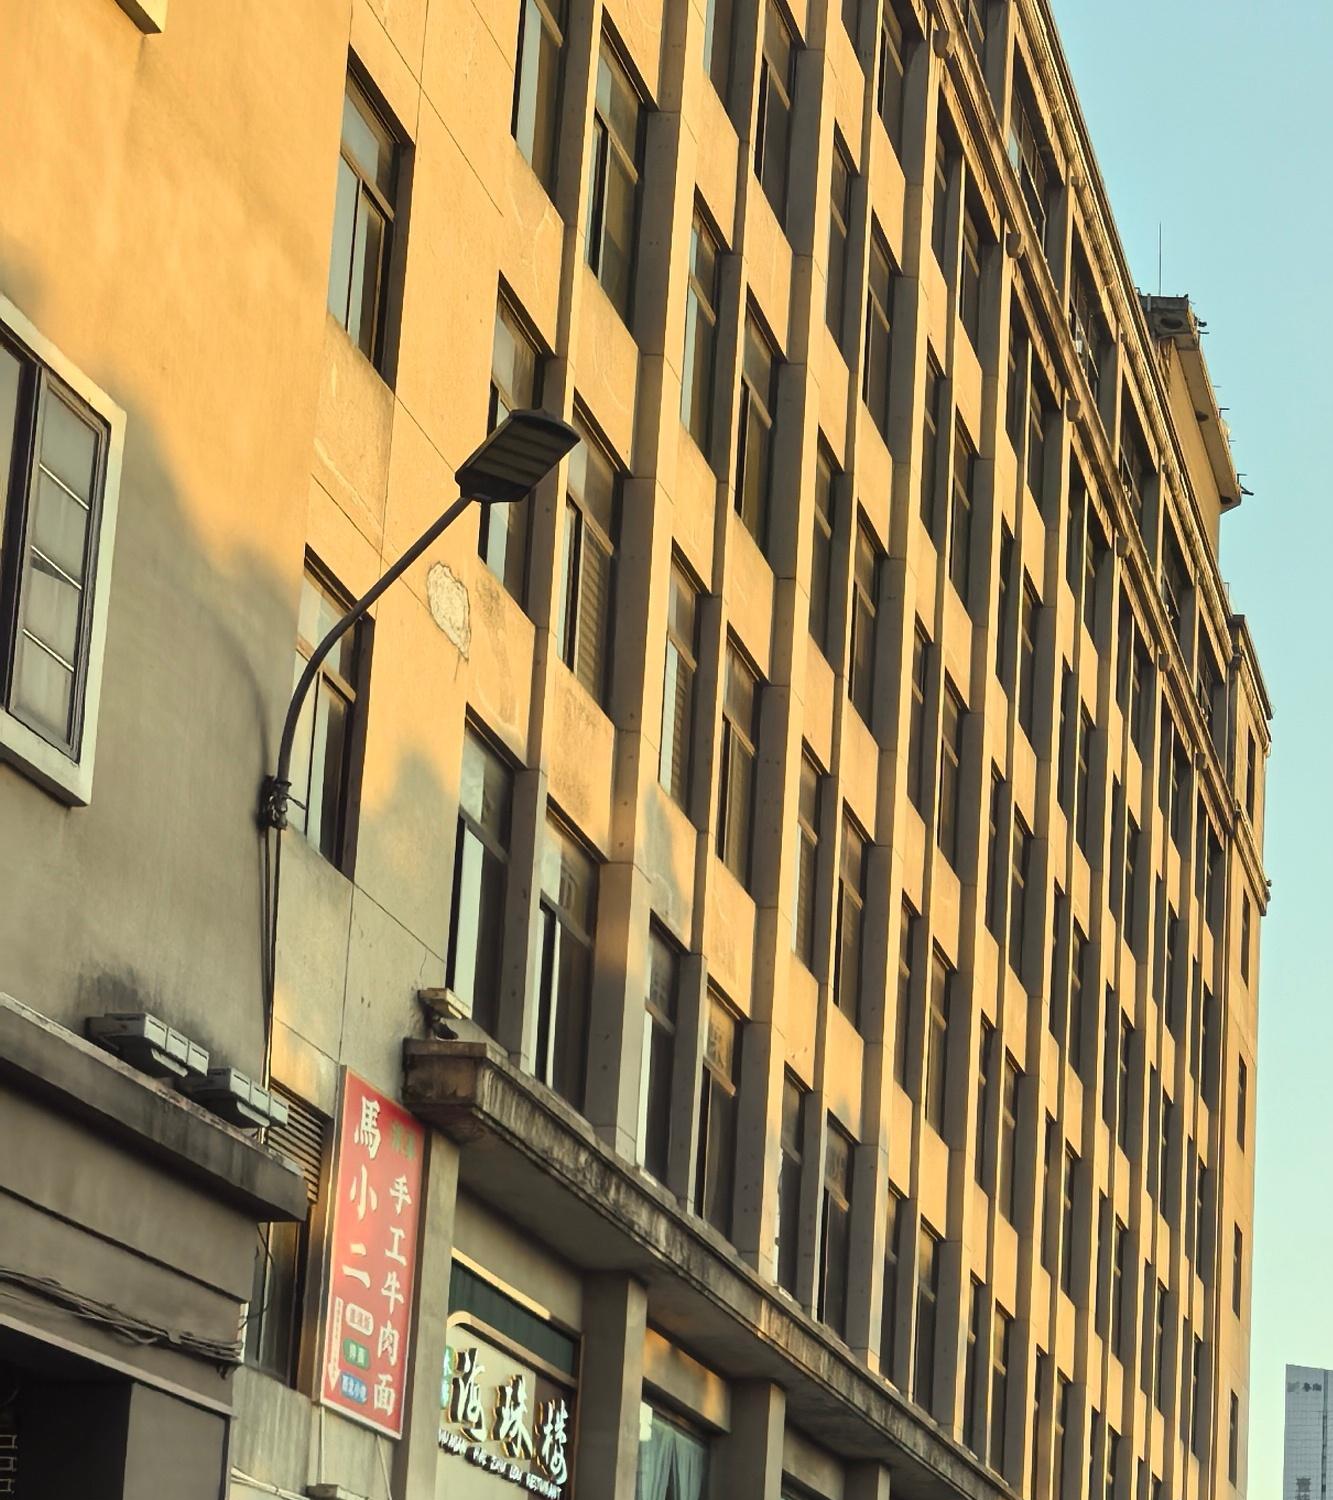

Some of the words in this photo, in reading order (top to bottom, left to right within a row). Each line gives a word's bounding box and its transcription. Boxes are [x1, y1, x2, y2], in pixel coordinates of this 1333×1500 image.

[342, 1095, 382, 1289] 馬小二
[373, 1175, 412, 1417] 手工牛肉面
